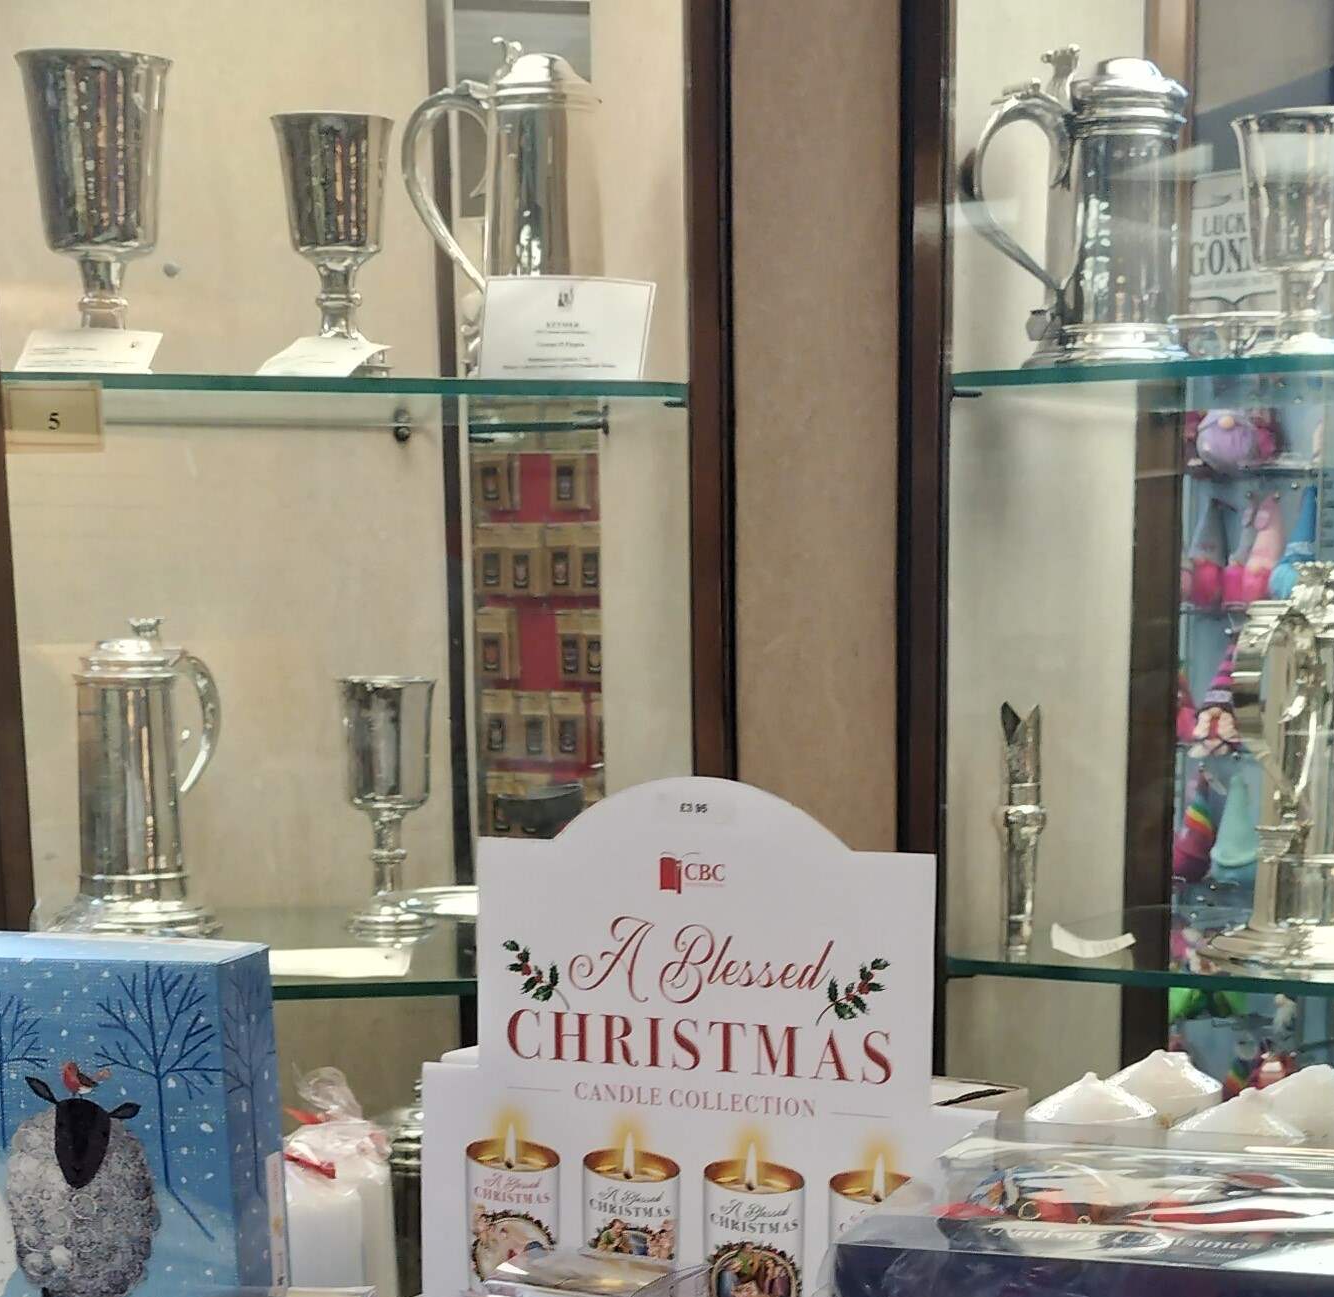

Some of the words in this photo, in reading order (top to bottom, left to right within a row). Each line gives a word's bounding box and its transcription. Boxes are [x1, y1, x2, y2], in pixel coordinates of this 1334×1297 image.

[1202, 213, 1246, 235] LUCK
[48, 412, 61, 430] 5
[685, 863, 725, 882] CBC
[568, 915, 654, 1004] A
[659, 923, 835, 1005] Blessed
[506, 1008, 893, 1085] CHRISTMAS
[573, 1080, 662, 1109] CANDLE
[668, 1086, 816, 1118] COLLECTION
[473, 1187, 551, 1205] CHRISTMAS
[589, 1198, 671, 1217] CHRISTMAS
[710, 1213, 799, 1234] CHRISTMAS
